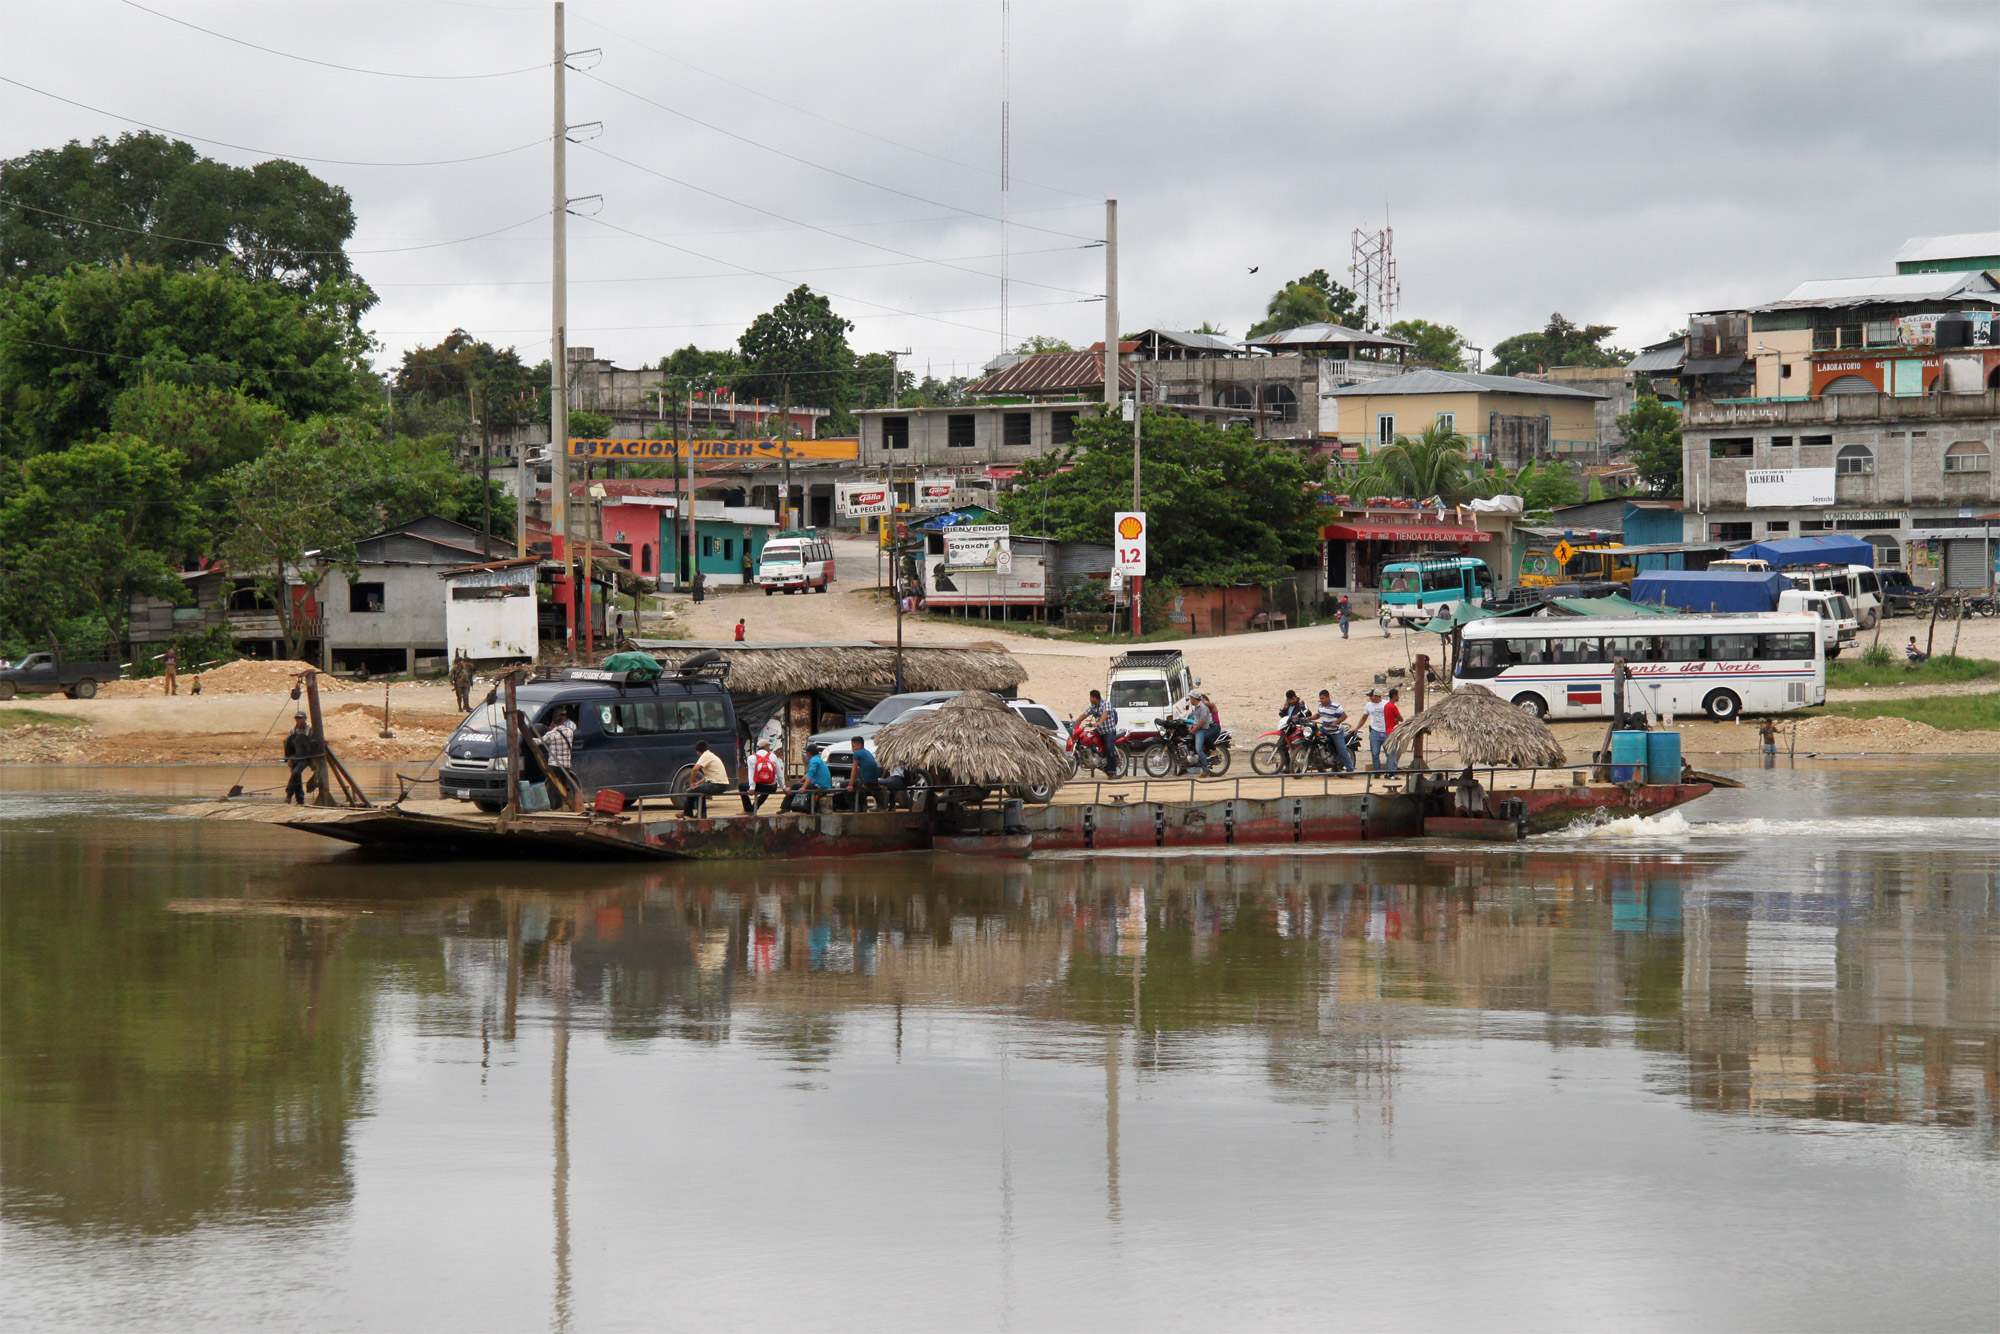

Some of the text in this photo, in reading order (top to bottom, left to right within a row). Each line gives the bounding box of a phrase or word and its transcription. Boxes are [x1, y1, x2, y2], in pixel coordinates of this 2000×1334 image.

[1817, 362, 1861, 372] LABORATORIO
[574, 441, 753, 456] ESTACION JIREH
[1749, 475, 1784, 483] ARMERIA
[859, 493, 882, 502] Gallo
[860, 504, 886, 514] PECERA
[1823, 511, 1909, 520] COMEDOR ESTRELLITA
[943, 525, 1009, 533] BIENVENIDOS
[1395, 532, 1422, 541] TIENDA
[1423, 533, 1433, 541] LA
[1434, 533, 1457, 542] PLAYA
[949, 541, 990, 551] Sayaxché
[1120, 548, 1140, 563] 1.2
[1680, 663, 1705, 672] del
[1714, 662, 1761, 671] Norte
